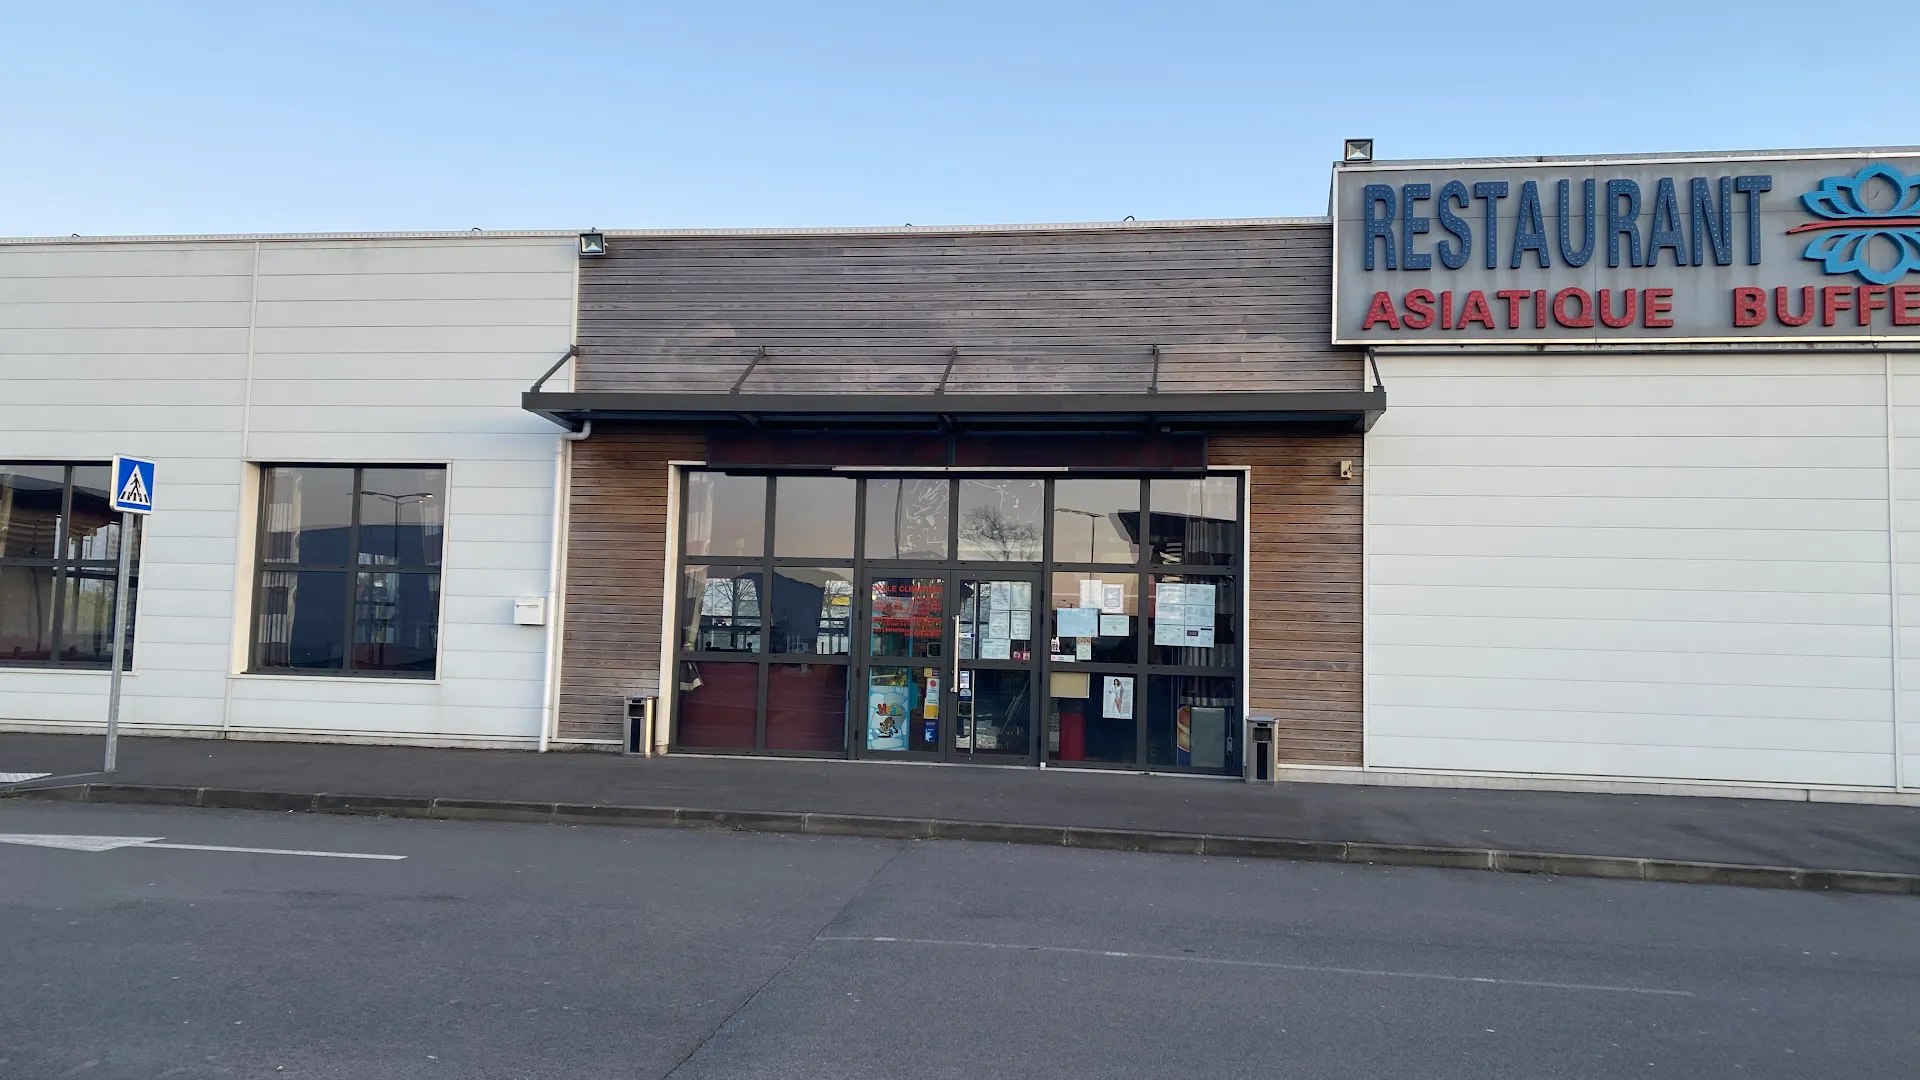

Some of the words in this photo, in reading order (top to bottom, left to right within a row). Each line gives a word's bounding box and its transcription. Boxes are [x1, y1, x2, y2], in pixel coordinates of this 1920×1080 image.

[1364, 174, 1773, 271] RESTAURANT
[1361, 286, 1675, 330] ASIATIQUE
[1733, 284, 1920, 328] BUFFE
